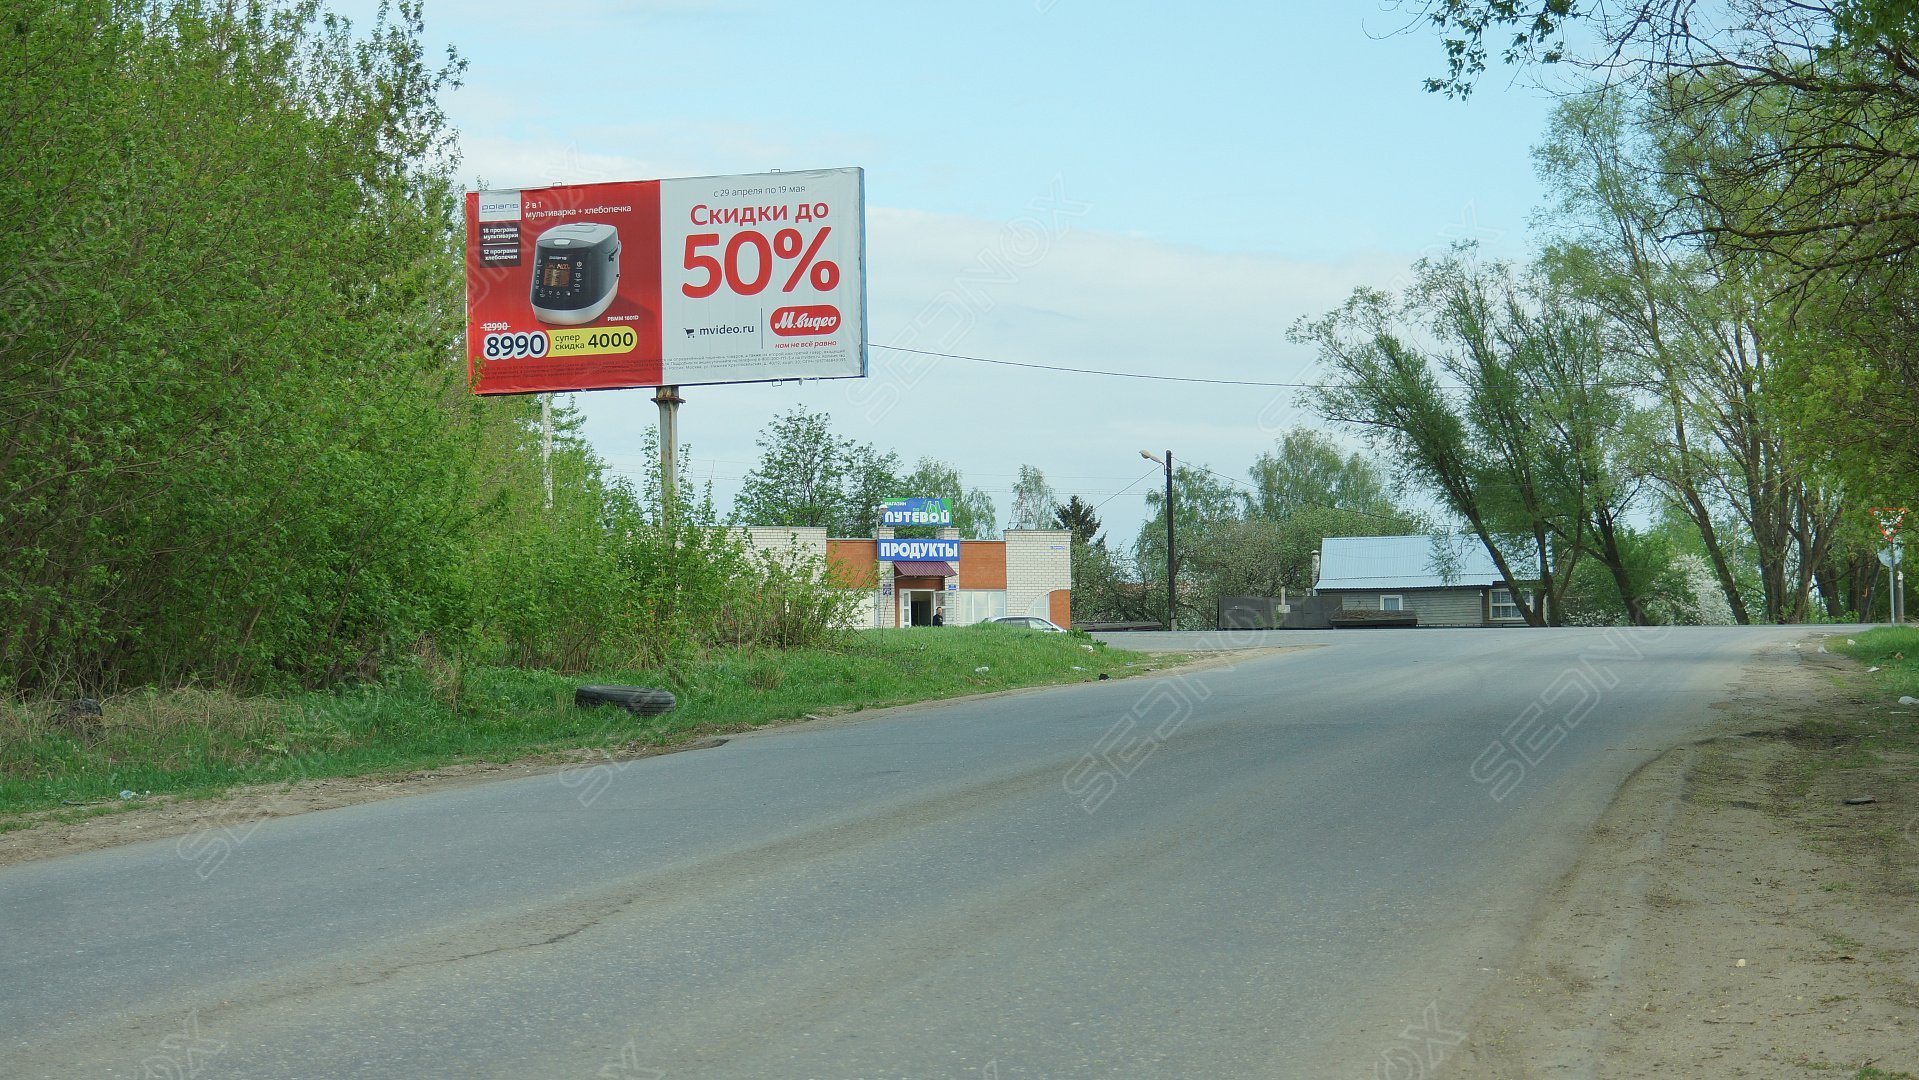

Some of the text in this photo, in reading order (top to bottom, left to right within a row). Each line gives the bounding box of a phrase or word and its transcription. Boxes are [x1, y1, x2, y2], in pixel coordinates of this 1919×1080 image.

[720, 189, 730, 197] 29
[732, 187, 763, 198] апреля
[765, 187, 777, 195] по
[778, 186, 787, 194] 19
[789, 185, 806, 193] мая
[481, 203, 519, 211] polaris
[525, 208, 577, 220] мультиварка
[584, 205, 632, 215] хлебопечка
[690, 202, 829, 226] Скидки до
[489, 227, 518, 235] программ
[489, 248, 518, 256] программ
[681, 226, 841, 299] 50%
[482, 322, 509, 331] 12990
[699, 324, 755, 336] mvideo.ru
[555, 334, 581, 343] супер
[587, 332, 634, 349] 4000
[814, 340, 837, 349] равно
[486, 334, 546, 358] 8990
[555, 343, 585, 351] скидка
[884, 509, 950, 523] ПУТЕВОЙ
[880, 542, 958, 559] ПРОДУКТЫ
